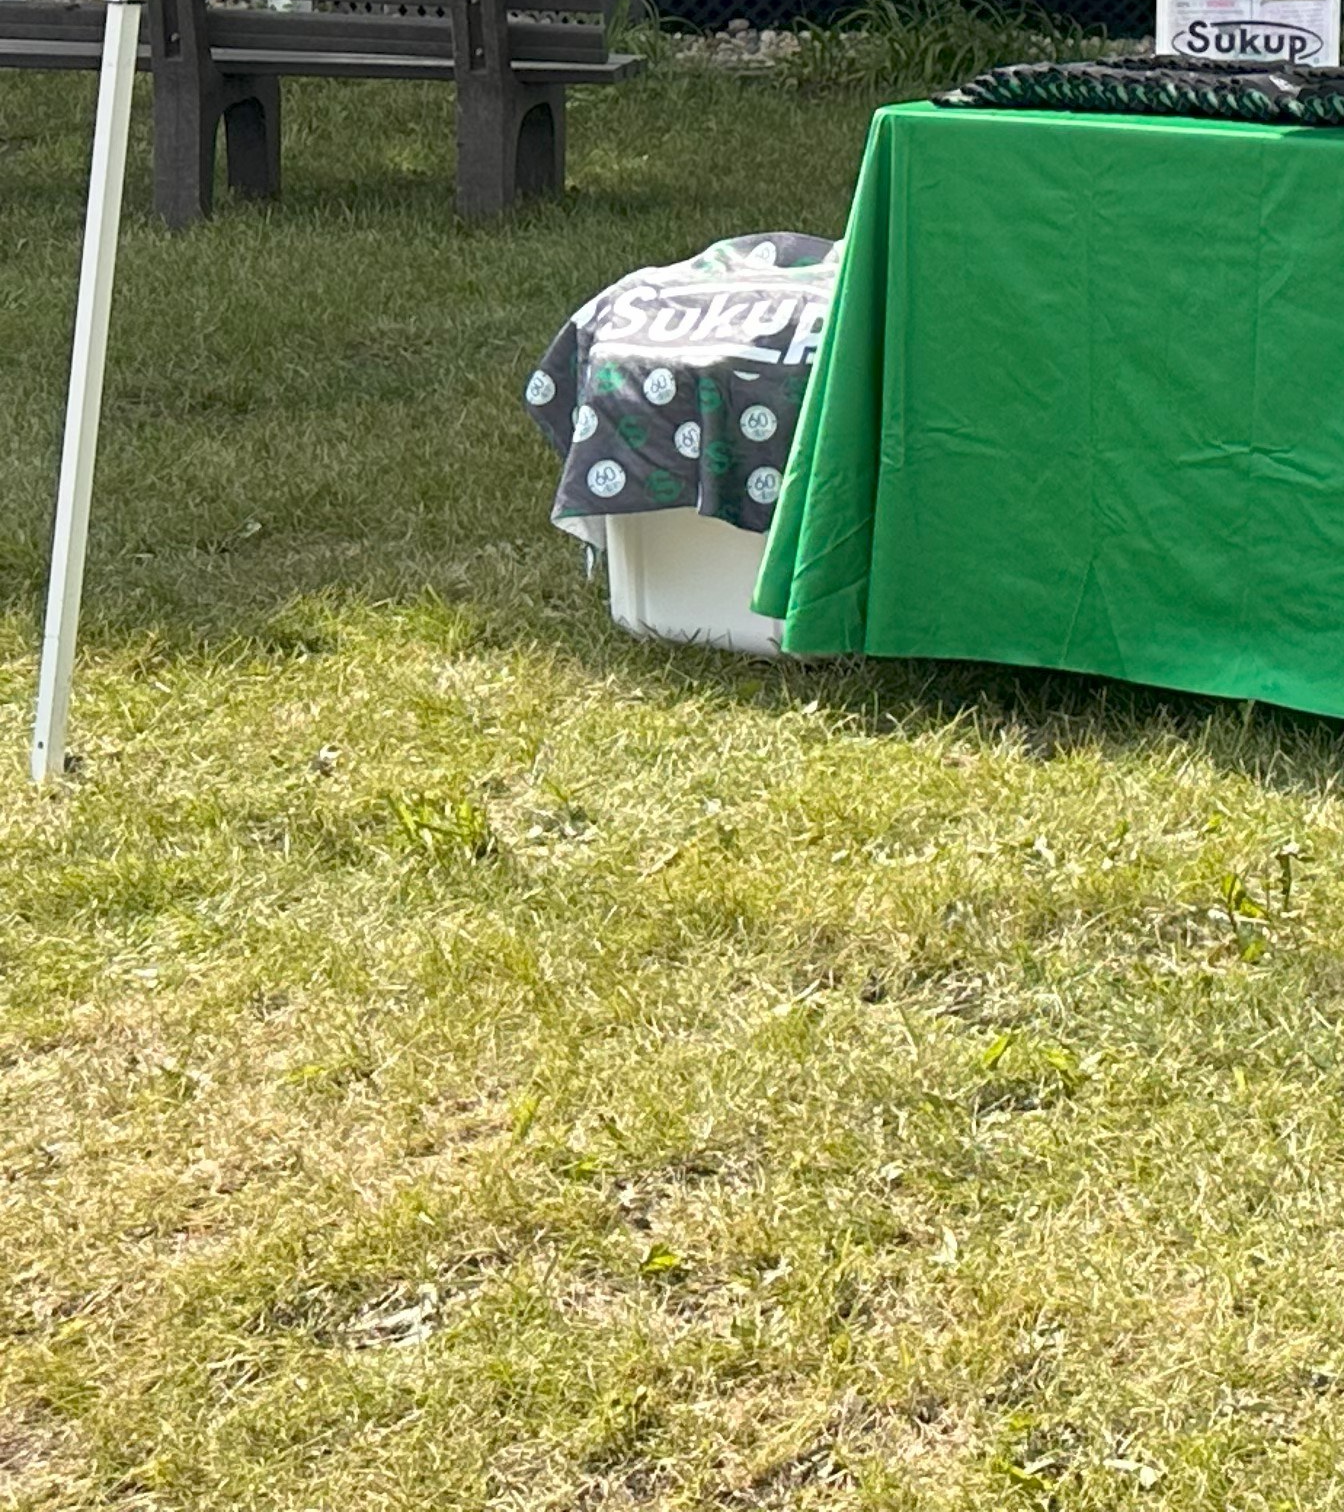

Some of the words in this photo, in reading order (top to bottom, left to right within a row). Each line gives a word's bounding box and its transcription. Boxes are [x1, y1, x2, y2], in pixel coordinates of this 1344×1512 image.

[1187, 20, 1307, 64] Sukup
[597, 286, 830, 365] Sukup
[748, 412, 768, 429] 60
[596, 466, 616, 486] 60
[755, 473, 776, 490] 60
